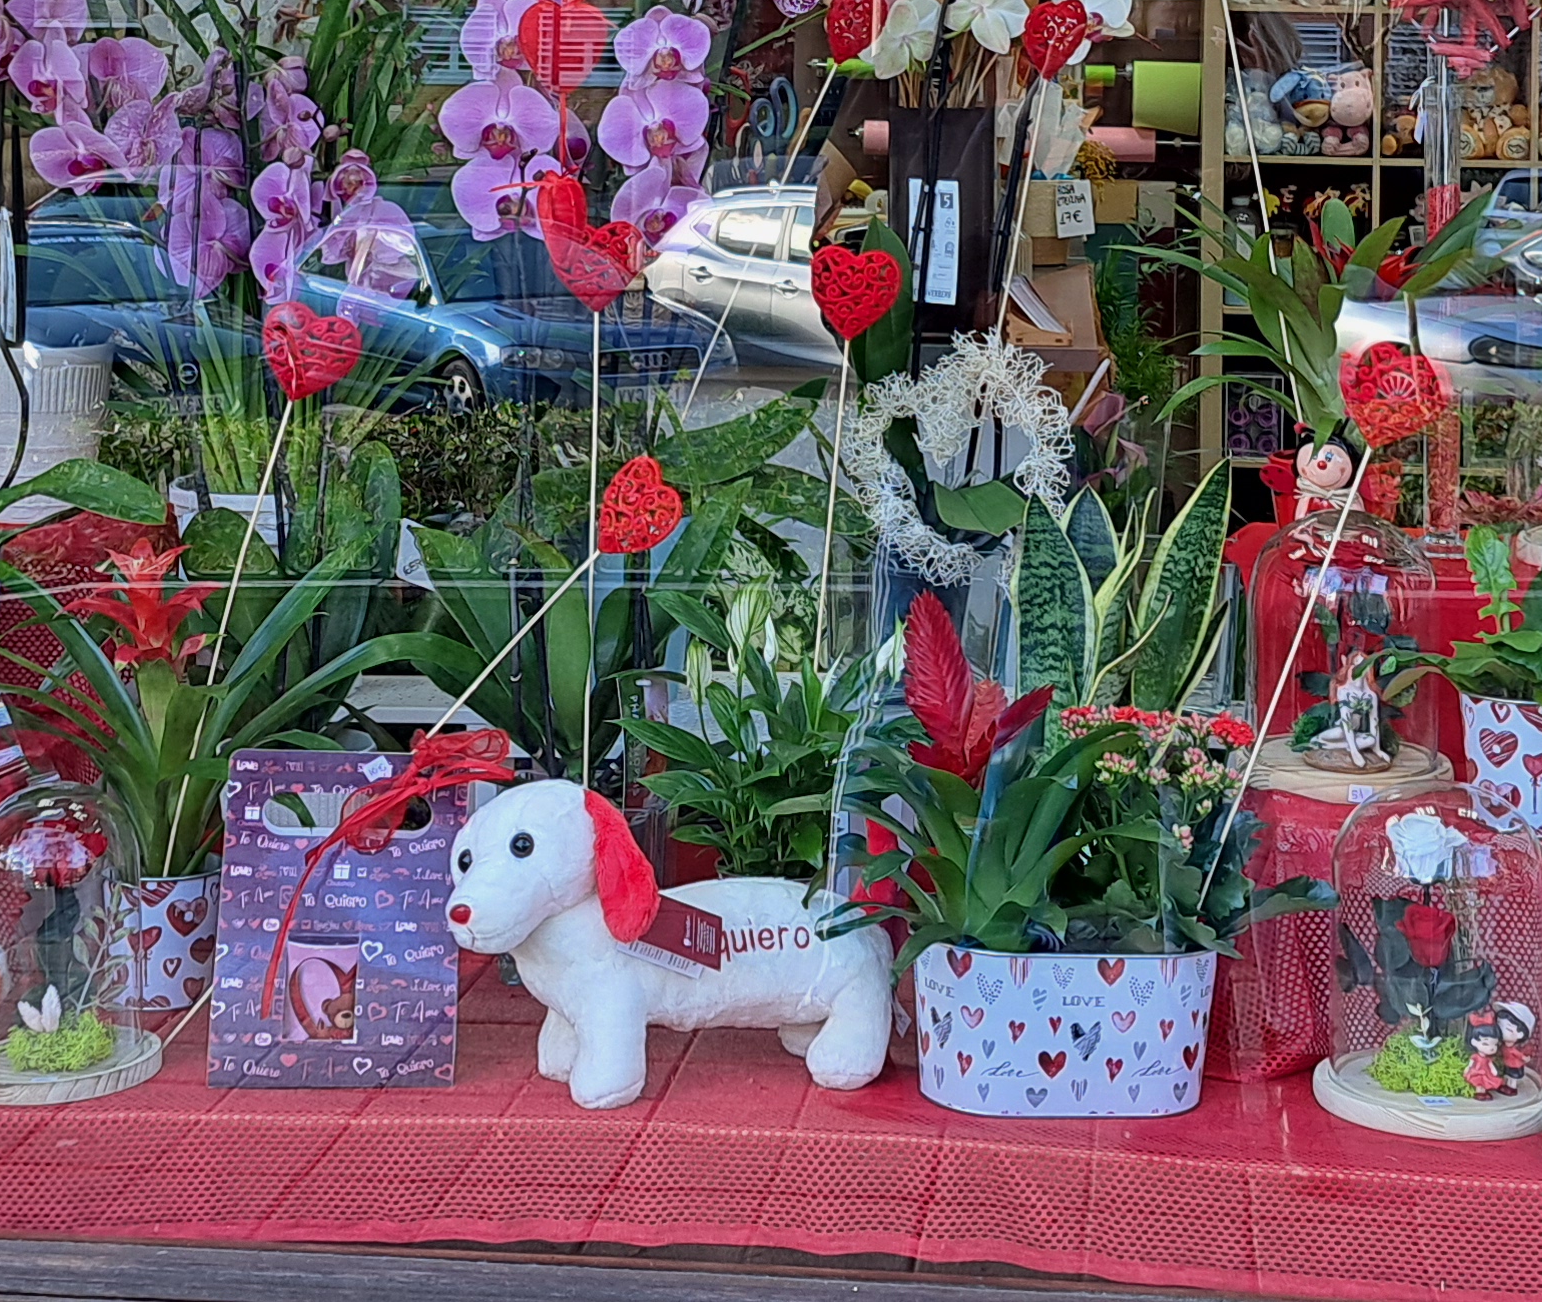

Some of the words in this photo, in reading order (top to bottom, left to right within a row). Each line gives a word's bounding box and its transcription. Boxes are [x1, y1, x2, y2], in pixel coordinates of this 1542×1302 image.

[721, 915, 811, 962] quiero
[923, 976, 956, 999] LOVE
[1061, 995, 1106, 1008] LOVE
